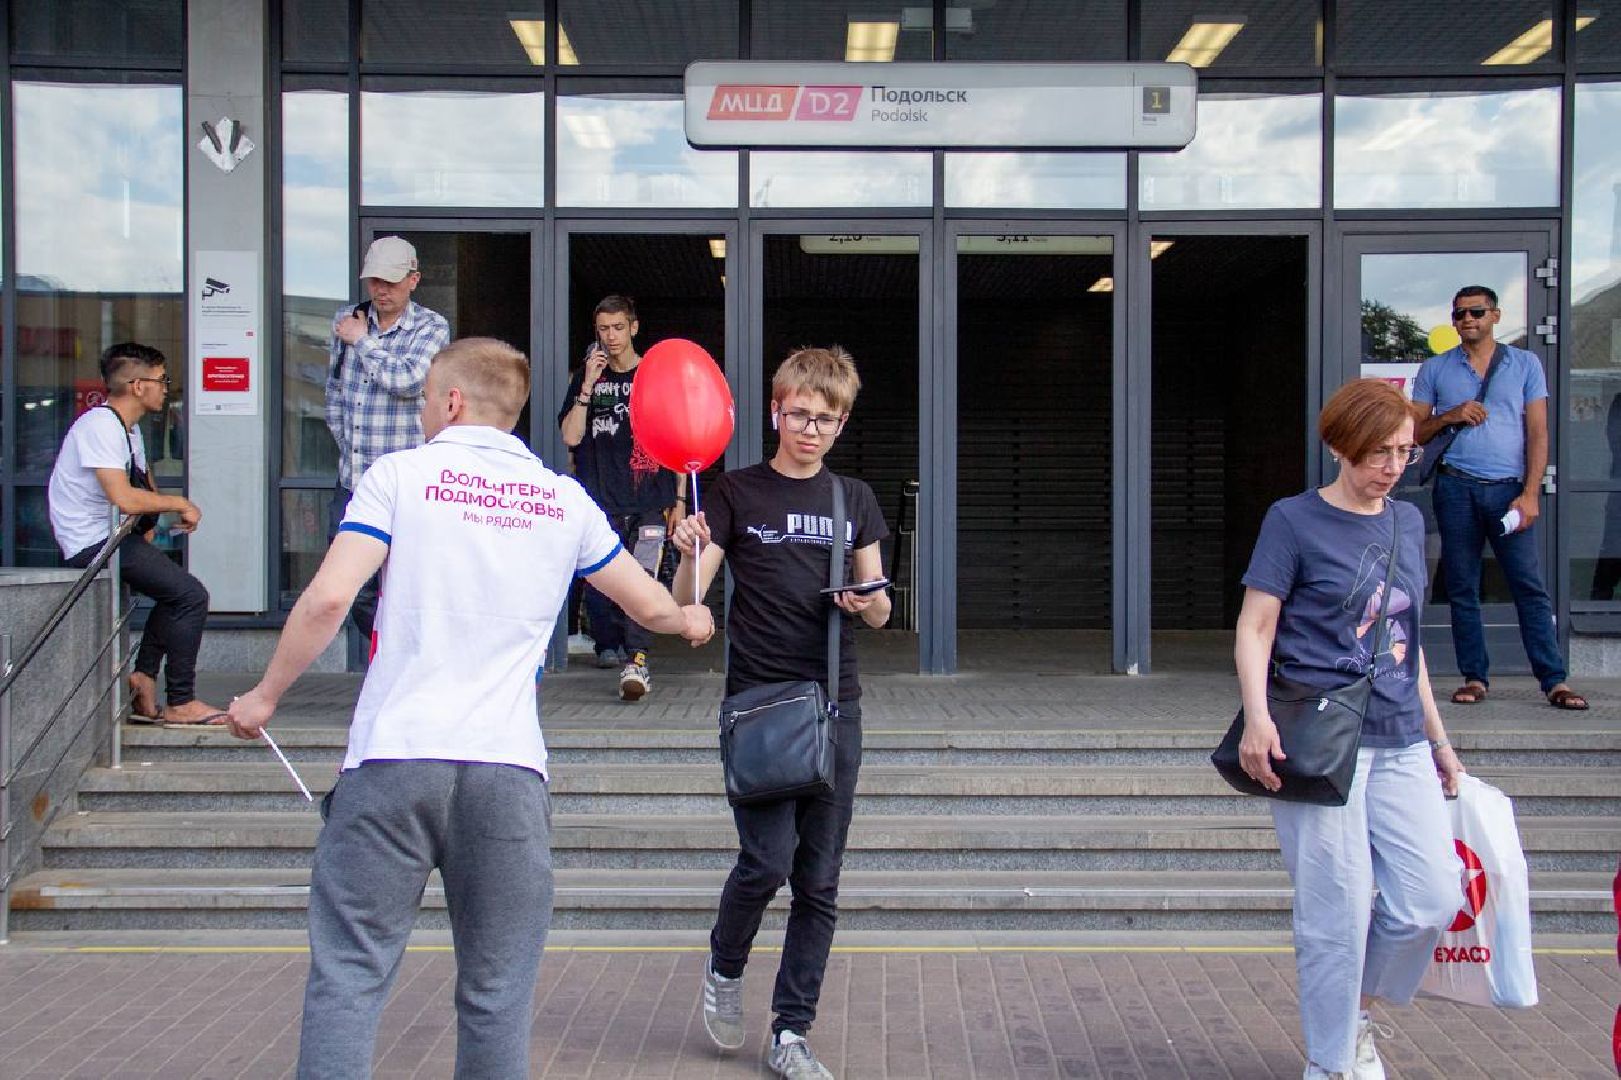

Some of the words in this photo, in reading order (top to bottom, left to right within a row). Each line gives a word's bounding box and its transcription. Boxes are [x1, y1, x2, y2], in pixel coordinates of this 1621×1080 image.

[718, 92, 784, 113] МЦД
[808, 91, 850, 114] D2
[871, 86, 967, 105] Подольск
[1151, 92, 1163, 109] 1
[871, 109, 929, 122] Podolsk
[486, 515, 532, 531] РЯДОМ
[1433, 946, 1491, 963] EXACO
